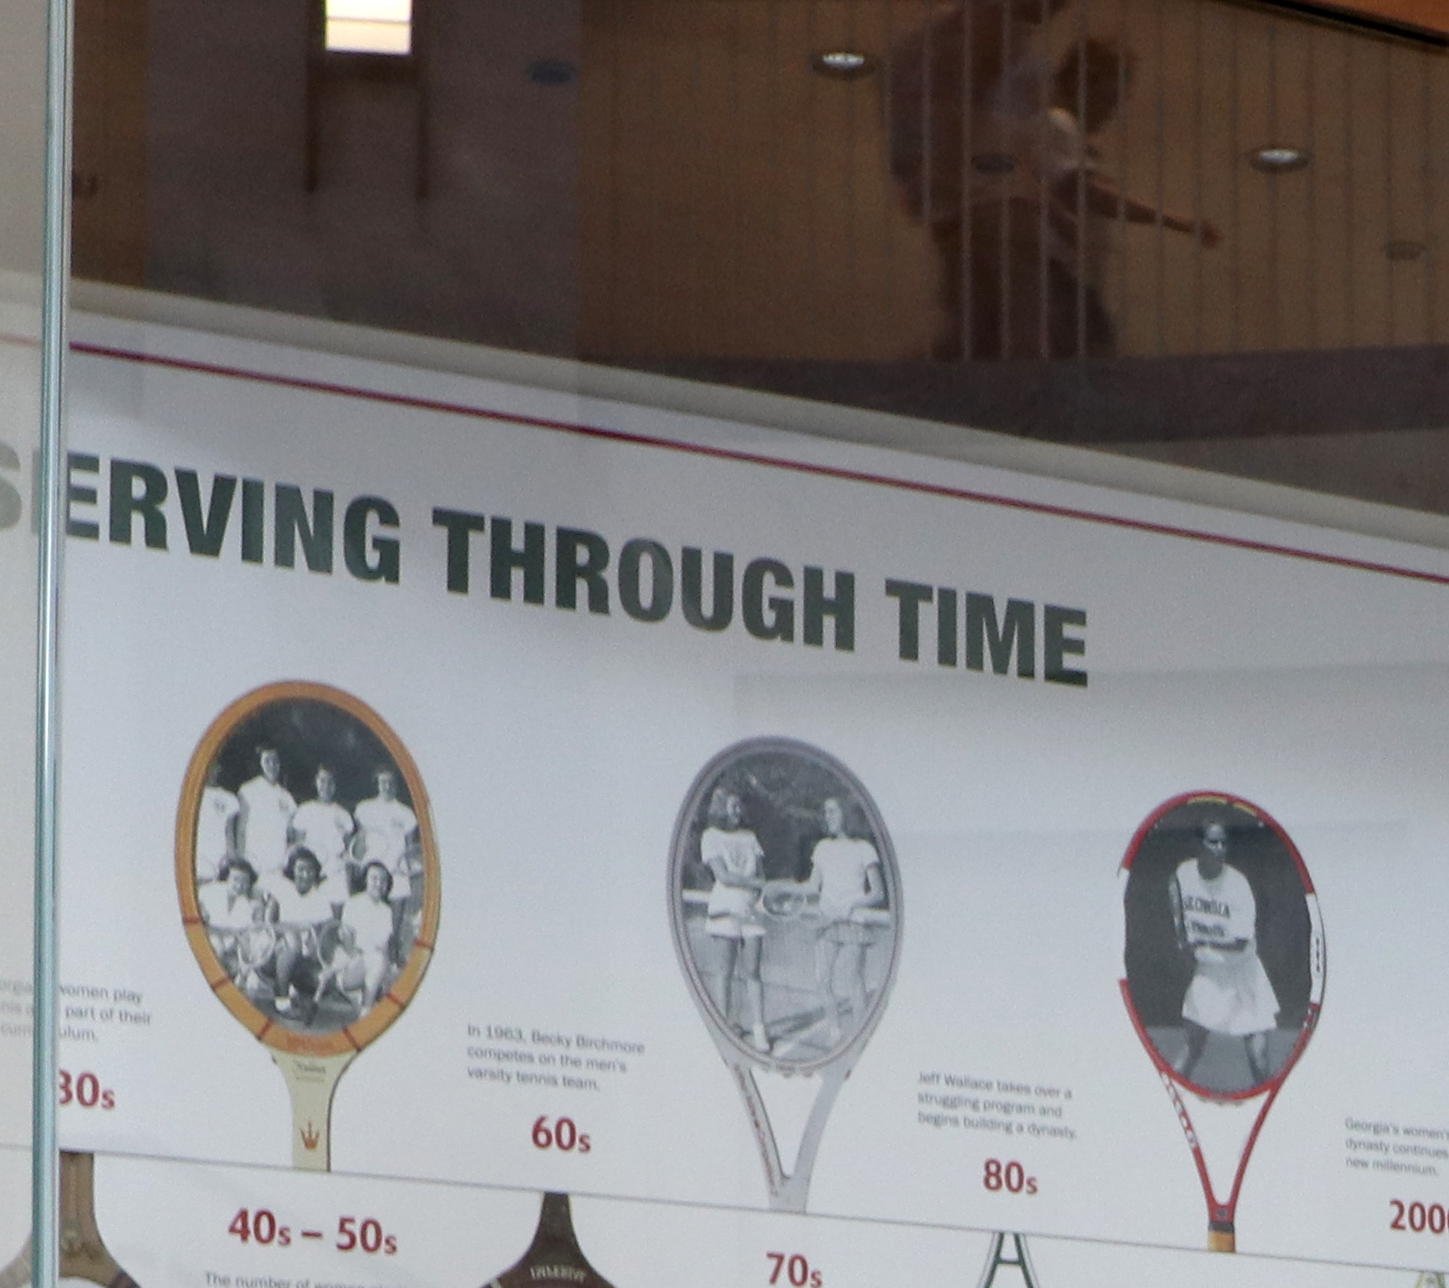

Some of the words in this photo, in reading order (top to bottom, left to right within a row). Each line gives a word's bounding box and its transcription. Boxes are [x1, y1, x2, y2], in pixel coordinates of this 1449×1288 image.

[432, 507, 855, 652] THROUGH
[884, 578, 1088, 688] TIME
[113, 988, 143, 1004] play
[65, 1004, 96, 1020] part
[100, 1006, 114, 1020] of
[119, 1008, 151, 1025] their
[467, 1023, 480, 1037] In
[532, 1029, 571, 1048] Becky
[576, 1033, 646, 1053] Birchmore
[467, 1046, 534, 1065] competes
[538, 1053, 556, 1066] on
[560, 1054, 582, 1067] the
[586, 1057, 627, 1074] men's
[467, 1066, 513, 1085] varsity
[516, 1071, 559, 1087] tennis
[562, 1074, 600, 1091] team.
[918, 1072, 942, 1085] Jeff
[944, 1074, 994, 1090] Wallace
[996, 1080, 1032, 1095] takes
[1034, 1084, 1061, 1099] over
[1064, 1089, 1073, 1100] a
[918, 1092, 980, 1112] struggling
[983, 1100, 1036, 1116] program
[1039, 1104, 1063, 1119] and
[532, 1114, 592, 1154] 60s
[918, 1110, 960, 1128] begins
[963, 1114, 1013, 1135] building
[1027, 1122, 1078, 1140] dynasty.
[1345, 1117, 1400, 1136] Georgia's
[1345, 1137, 1390, 1155] dynasty
[1393, 1143, 1449, 1159] continues
[983, 1158, 1038, 1195] 80s
[1346, 1157, 1369, 1168] new
[1372, 1159, 1439, 1176] millennium.
[228, 1207, 292, 1246] 40s
[336, 1216, 398, 1255] 50s
[205, 1272, 231, 1286] The
[766, 1251, 823, 1288] 70s
